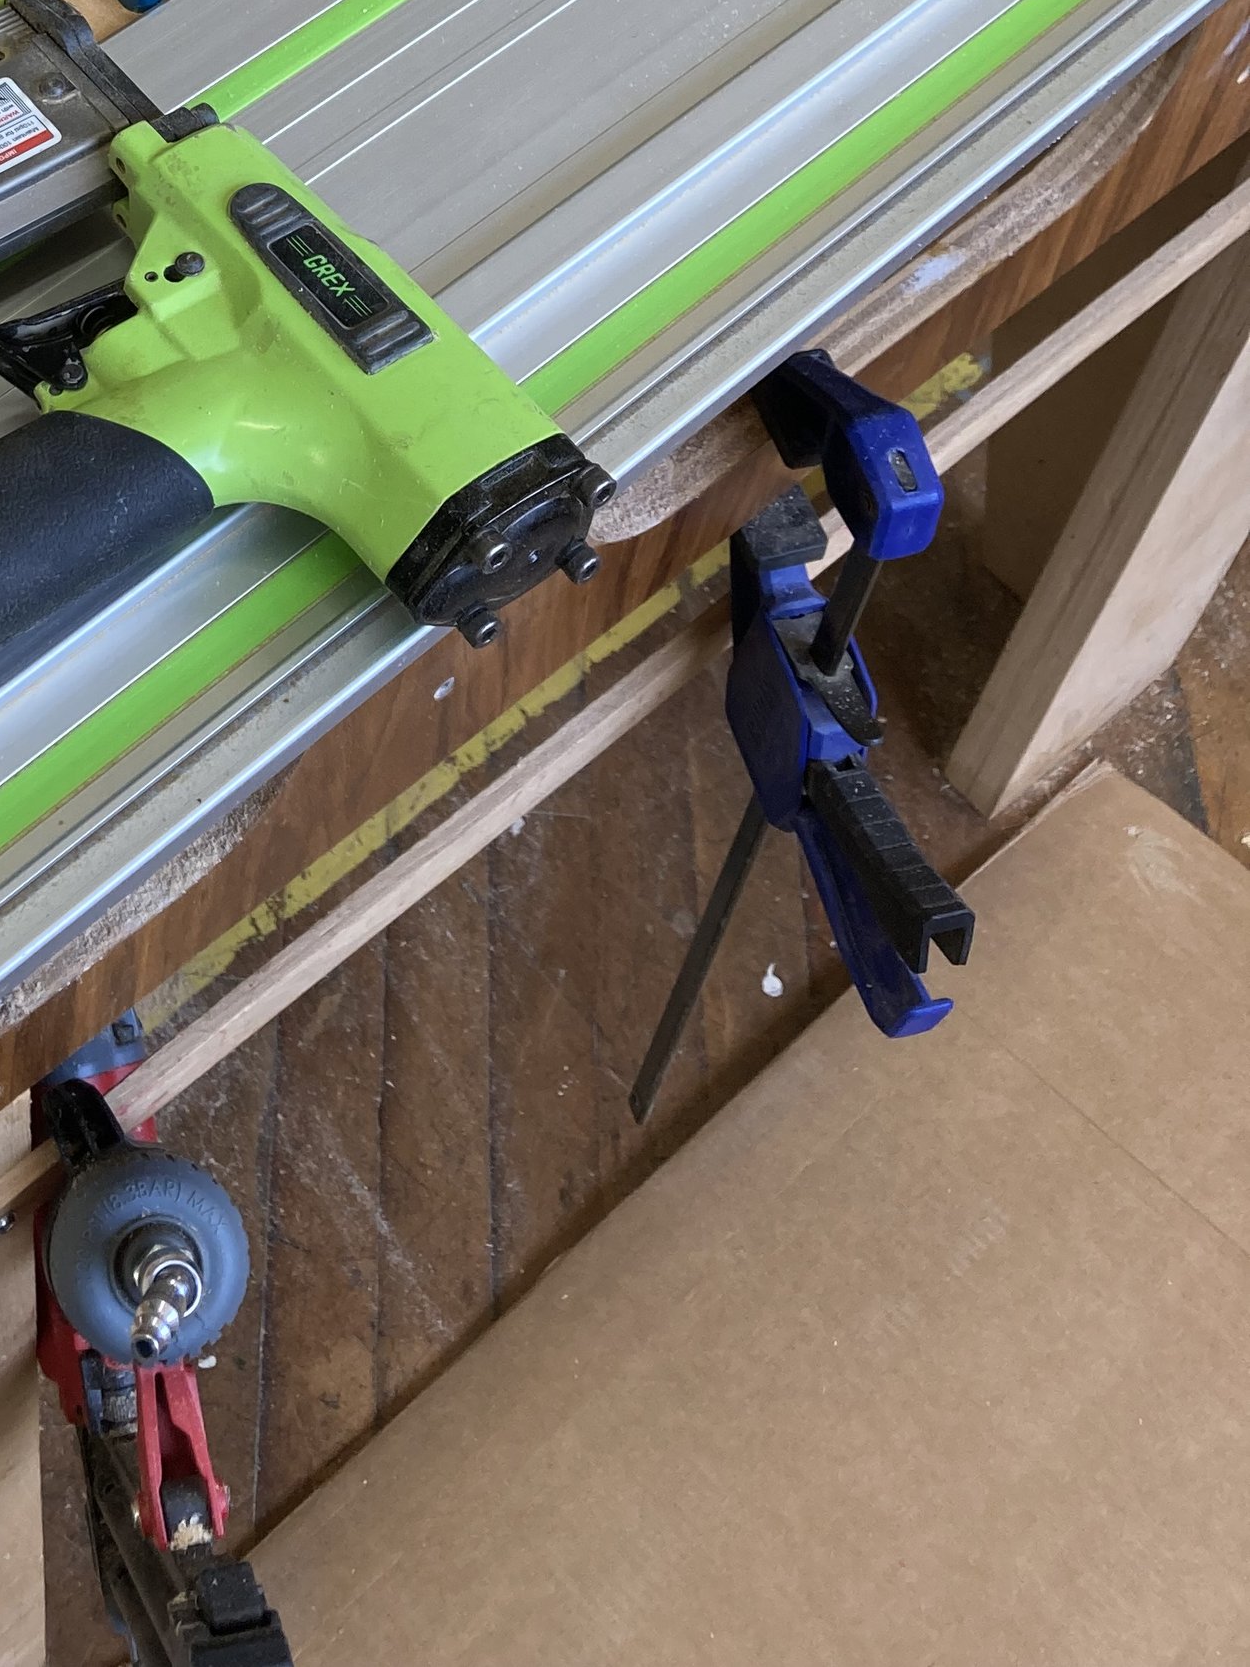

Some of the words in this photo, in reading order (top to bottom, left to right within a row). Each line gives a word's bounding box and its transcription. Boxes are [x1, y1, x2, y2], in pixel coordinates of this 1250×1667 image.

[0, 103, 15, 113] with
[4, 129, 14, 137] for
[12, 119, 33, 132] 110psi
[11, 125, 39, 142] Maintain
[303, 254, 356, 298] GREX
[185, 1188, 232, 1236] MAX
